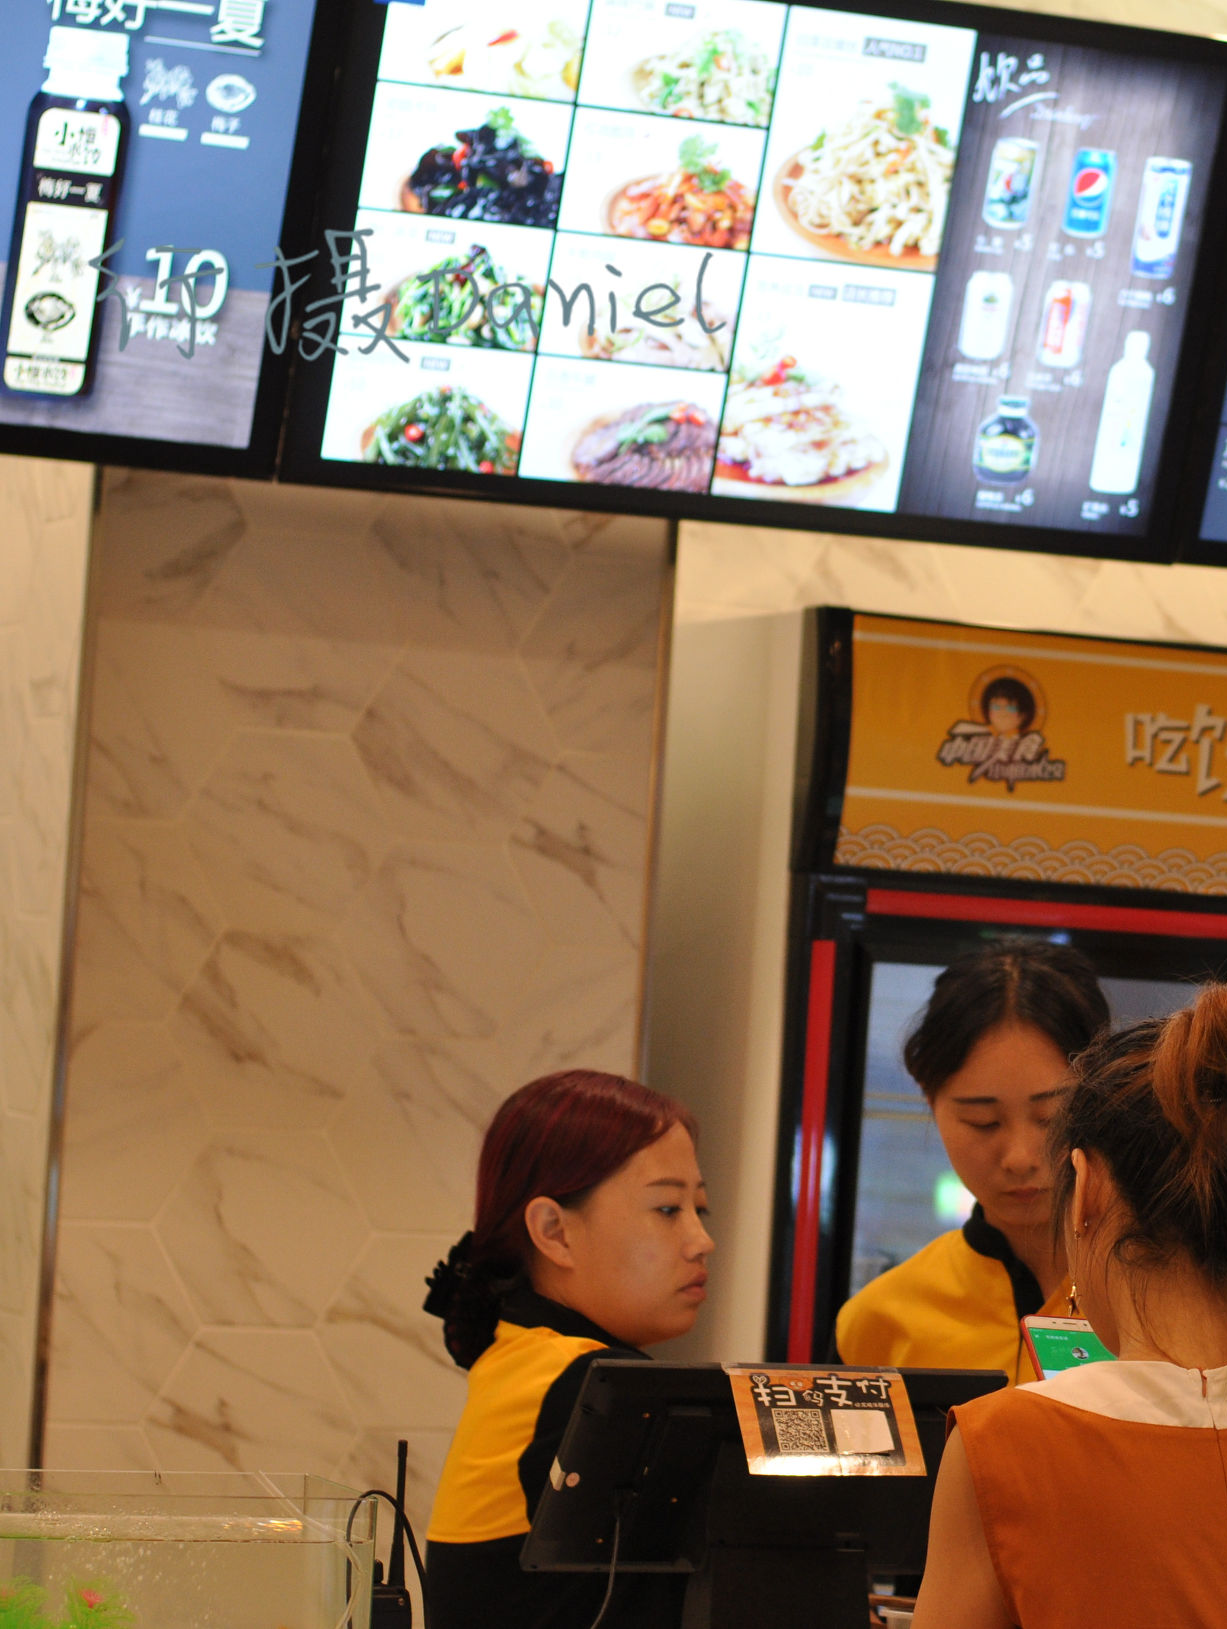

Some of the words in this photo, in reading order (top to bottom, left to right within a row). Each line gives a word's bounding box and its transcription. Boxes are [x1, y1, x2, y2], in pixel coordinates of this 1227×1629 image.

[972, 51, 1051, 103] 饮品
[752, 1374, 888, 1407] 扫码支付
